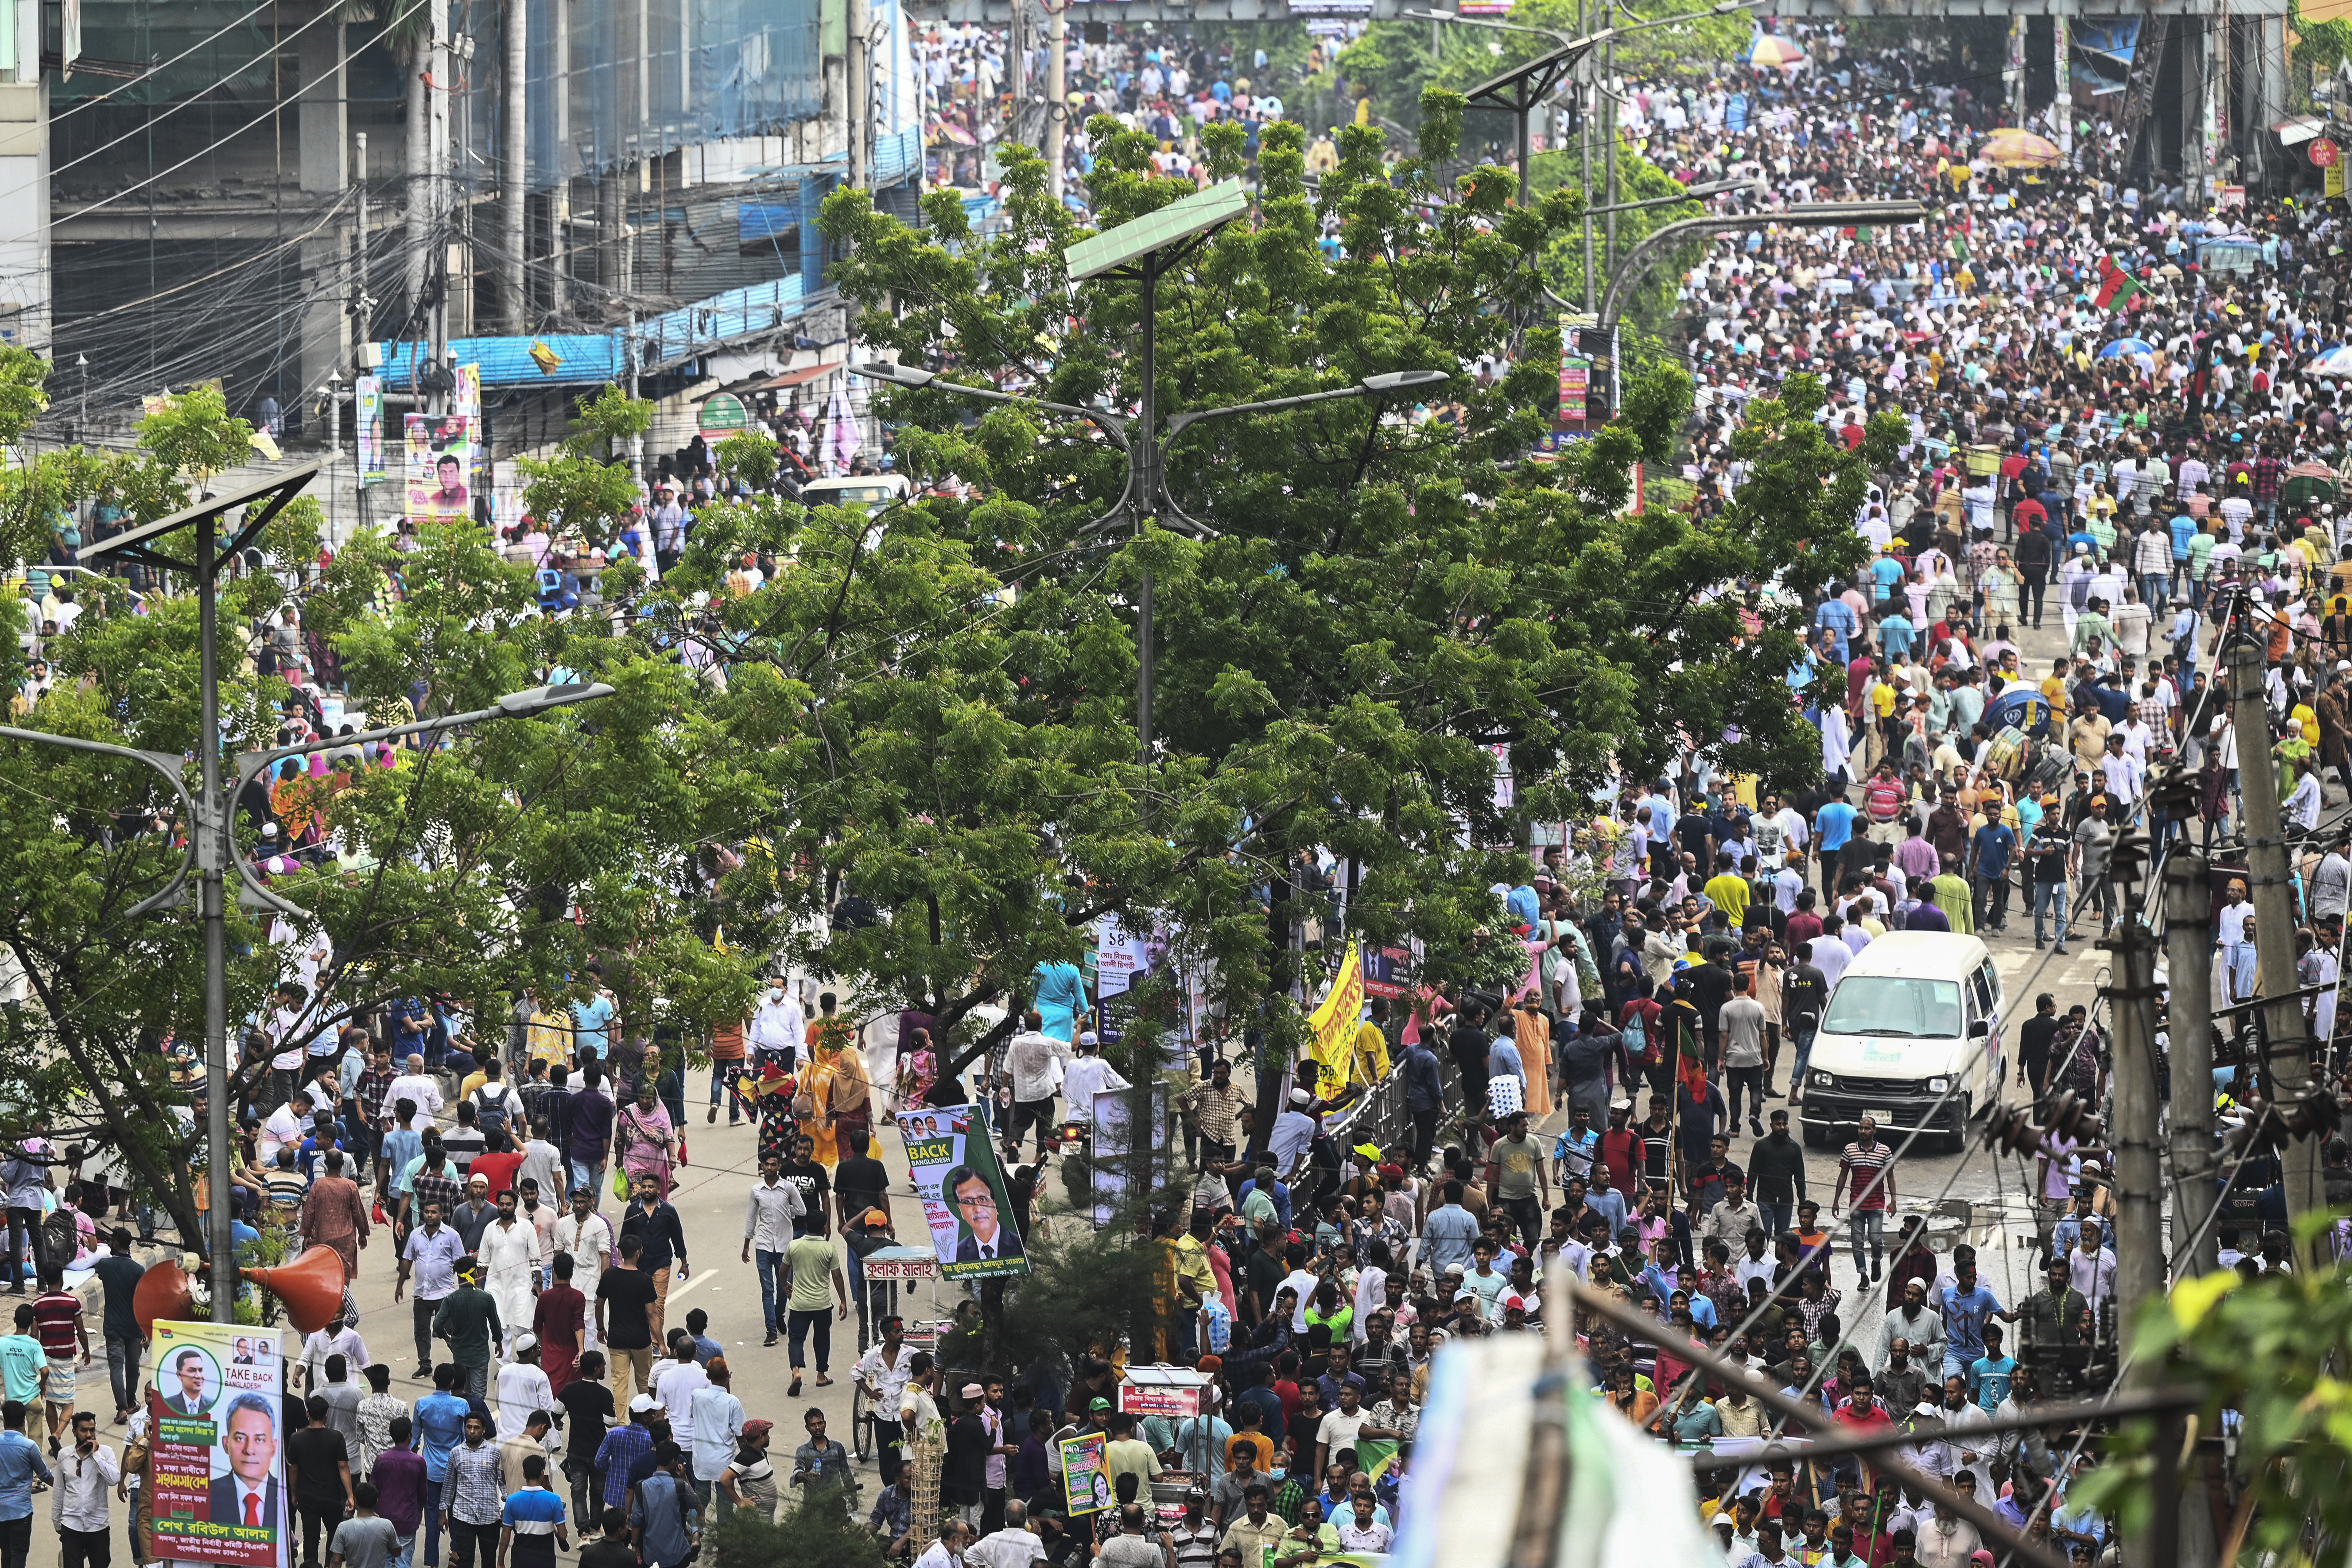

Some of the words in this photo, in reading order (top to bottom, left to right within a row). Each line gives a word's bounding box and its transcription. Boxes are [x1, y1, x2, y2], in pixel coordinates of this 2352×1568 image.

[1109, 932, 1124, 946] ১৪
[1114, 951, 1133, 961] নিয়াজ
[908, 1144, 949, 1159] BACK
[911, 1157, 951, 1166] BANGLADESH
[787, 1176, 815, 1187] NASA
[925, 1210, 950, 1221] হাসিনার
[930, 1221, 954, 1230] পদত্যাগ
[867, 1260, 899, 1278] কুলফি
[901, 1260, 933, 1277] মালাই
[953, 1262, 982, 1273] মুক্তিযোদ্ধা
[225, 1368, 250, 1380] TAKE
[253, 1373, 273, 1382] BACK
[180, 1465, 206, 1475] দাবীতে
[156, 1473, 208, 1490] মহাসমাবেশ
[158, 1521, 184, 1532] শেখ
[187, 1521, 229, 1537] রবিউল
[233, 1528, 270, 1540] আলম
[202, 1537, 221, 1547] নির্বাহী
[245, 1542, 268, 1551] বিএনপি
[223, 1549, 249, 1558] ঢাকা-১০
